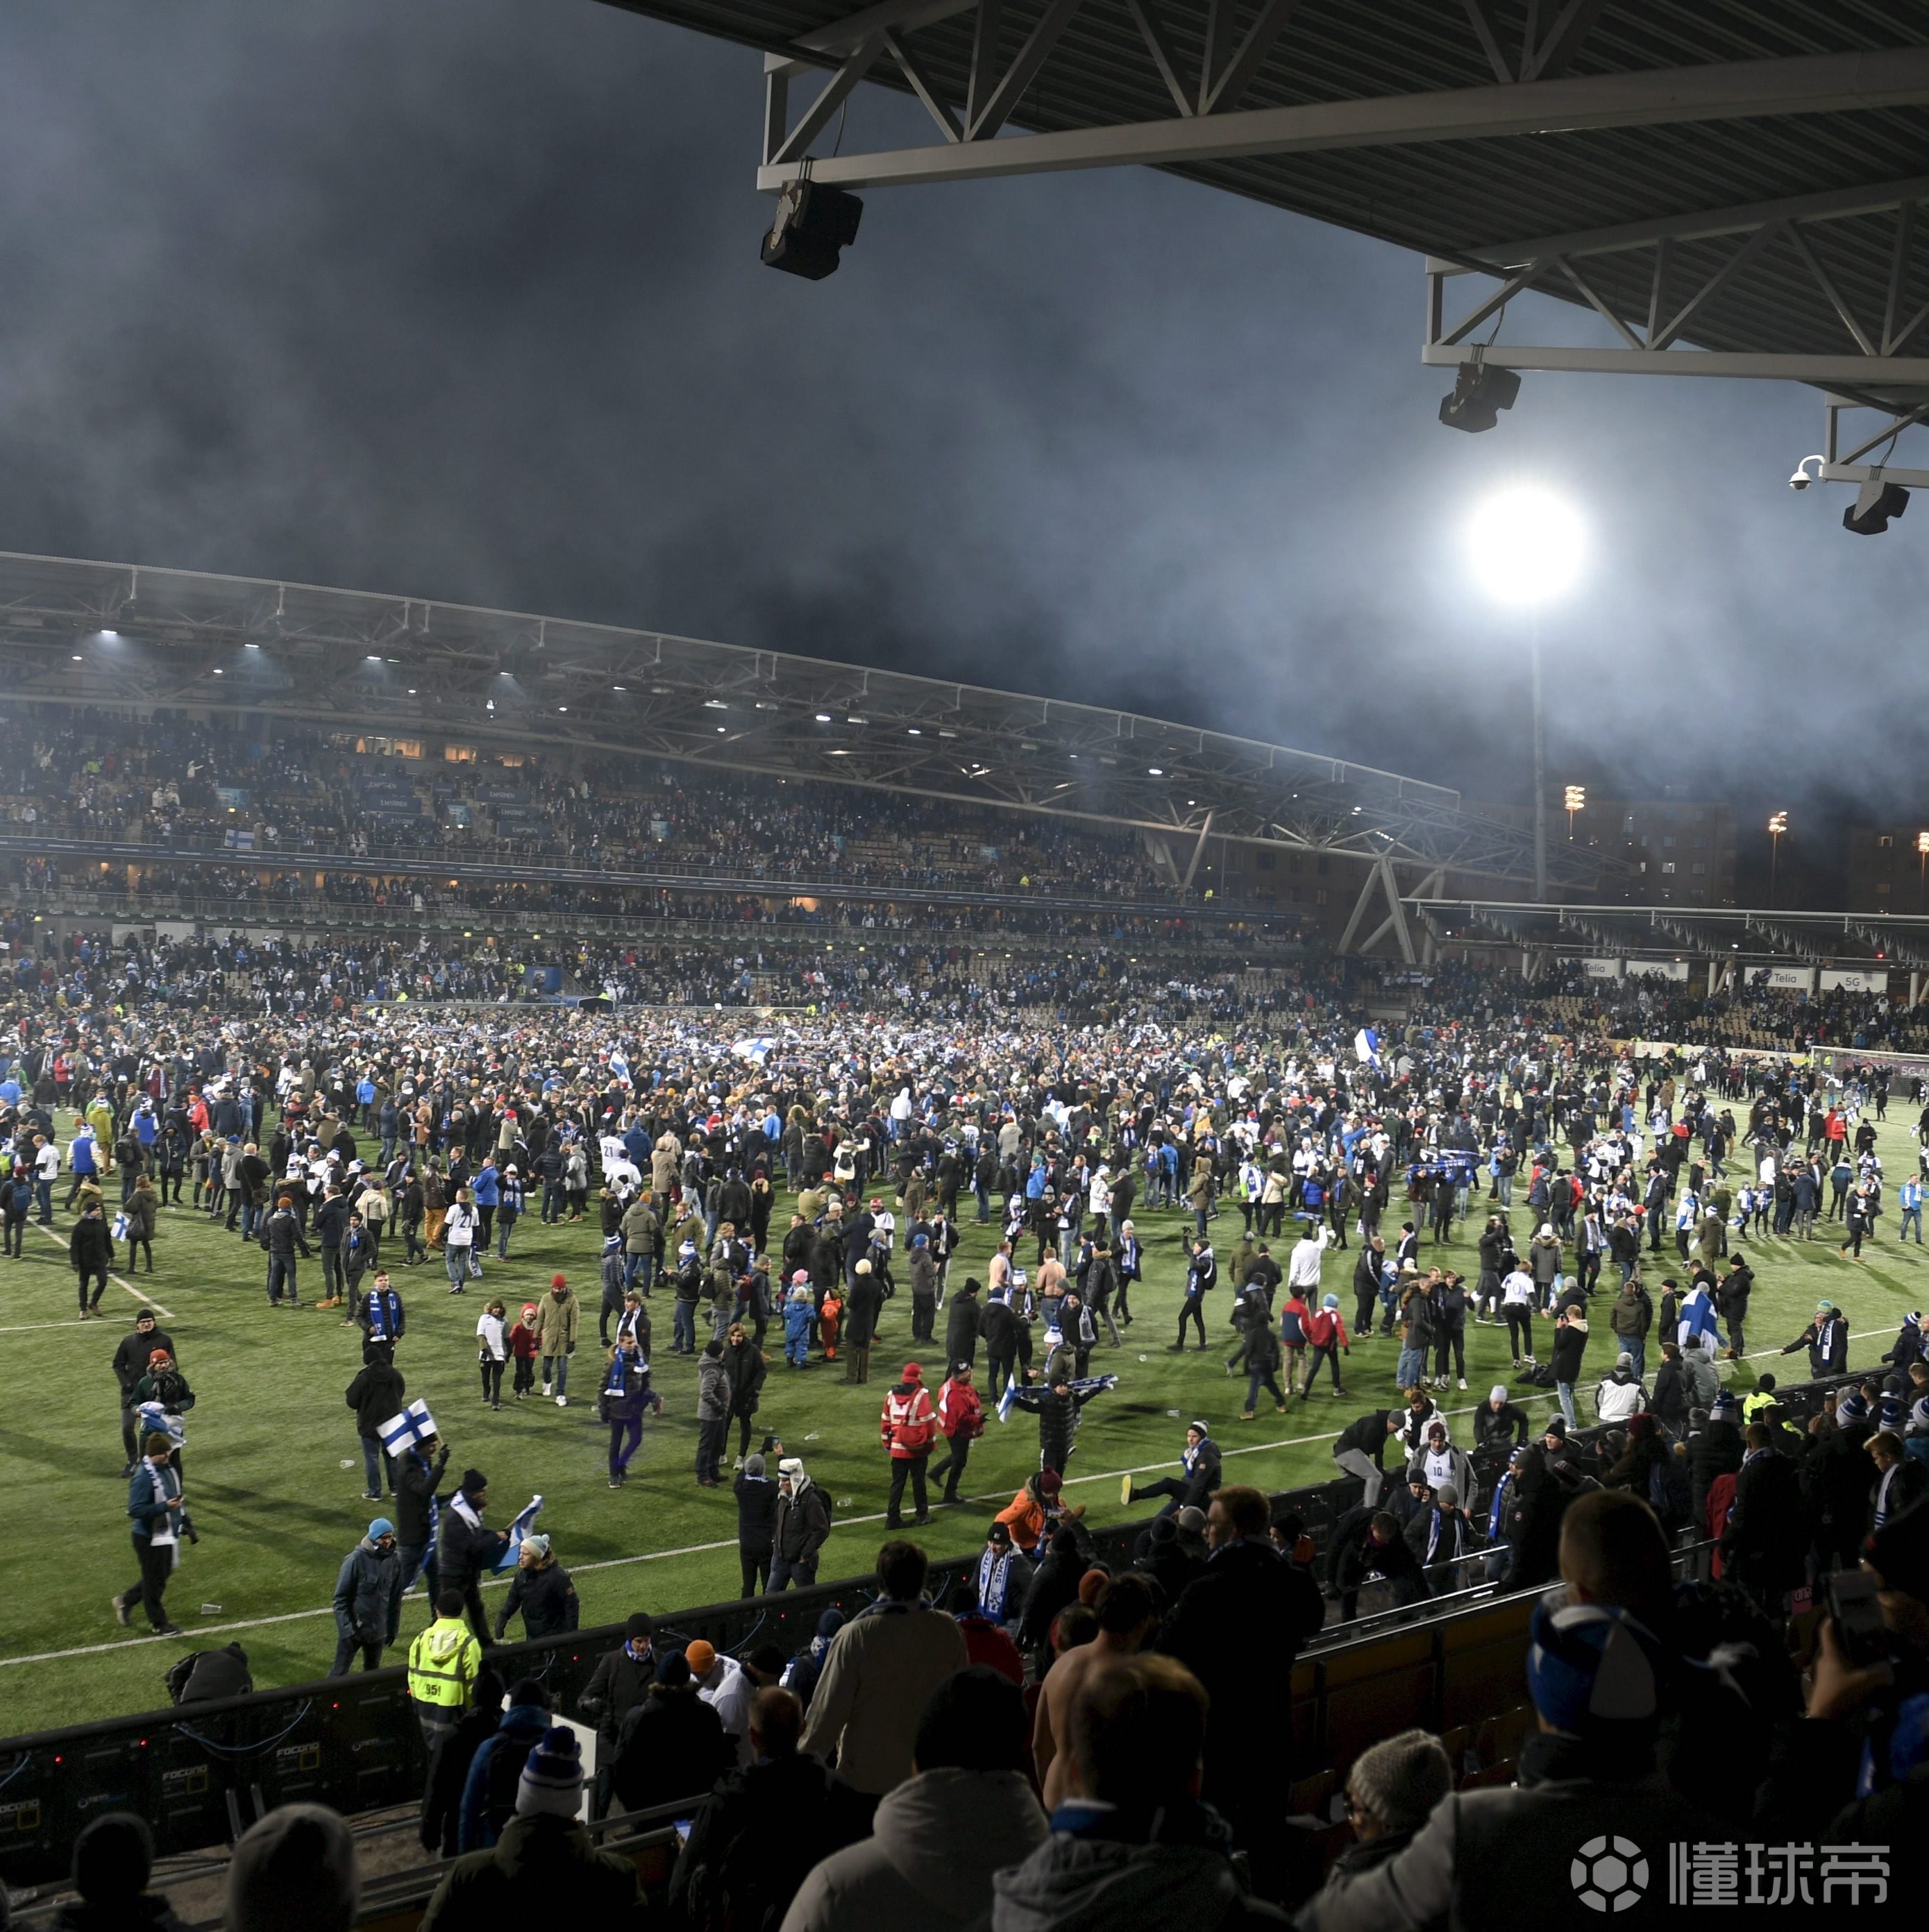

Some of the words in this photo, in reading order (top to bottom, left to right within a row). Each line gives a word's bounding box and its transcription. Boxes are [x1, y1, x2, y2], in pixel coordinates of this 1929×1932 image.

[1774, 973, 1797, 983] Telia
[1845, 977, 1860, 987] 5G
[1901, 1066, 1916, 1076] 5G
[603, 1145, 614, 1157] 21
[459, 1212, 473, 1228] 21
[1433, 1466, 1442, 1477] 10
